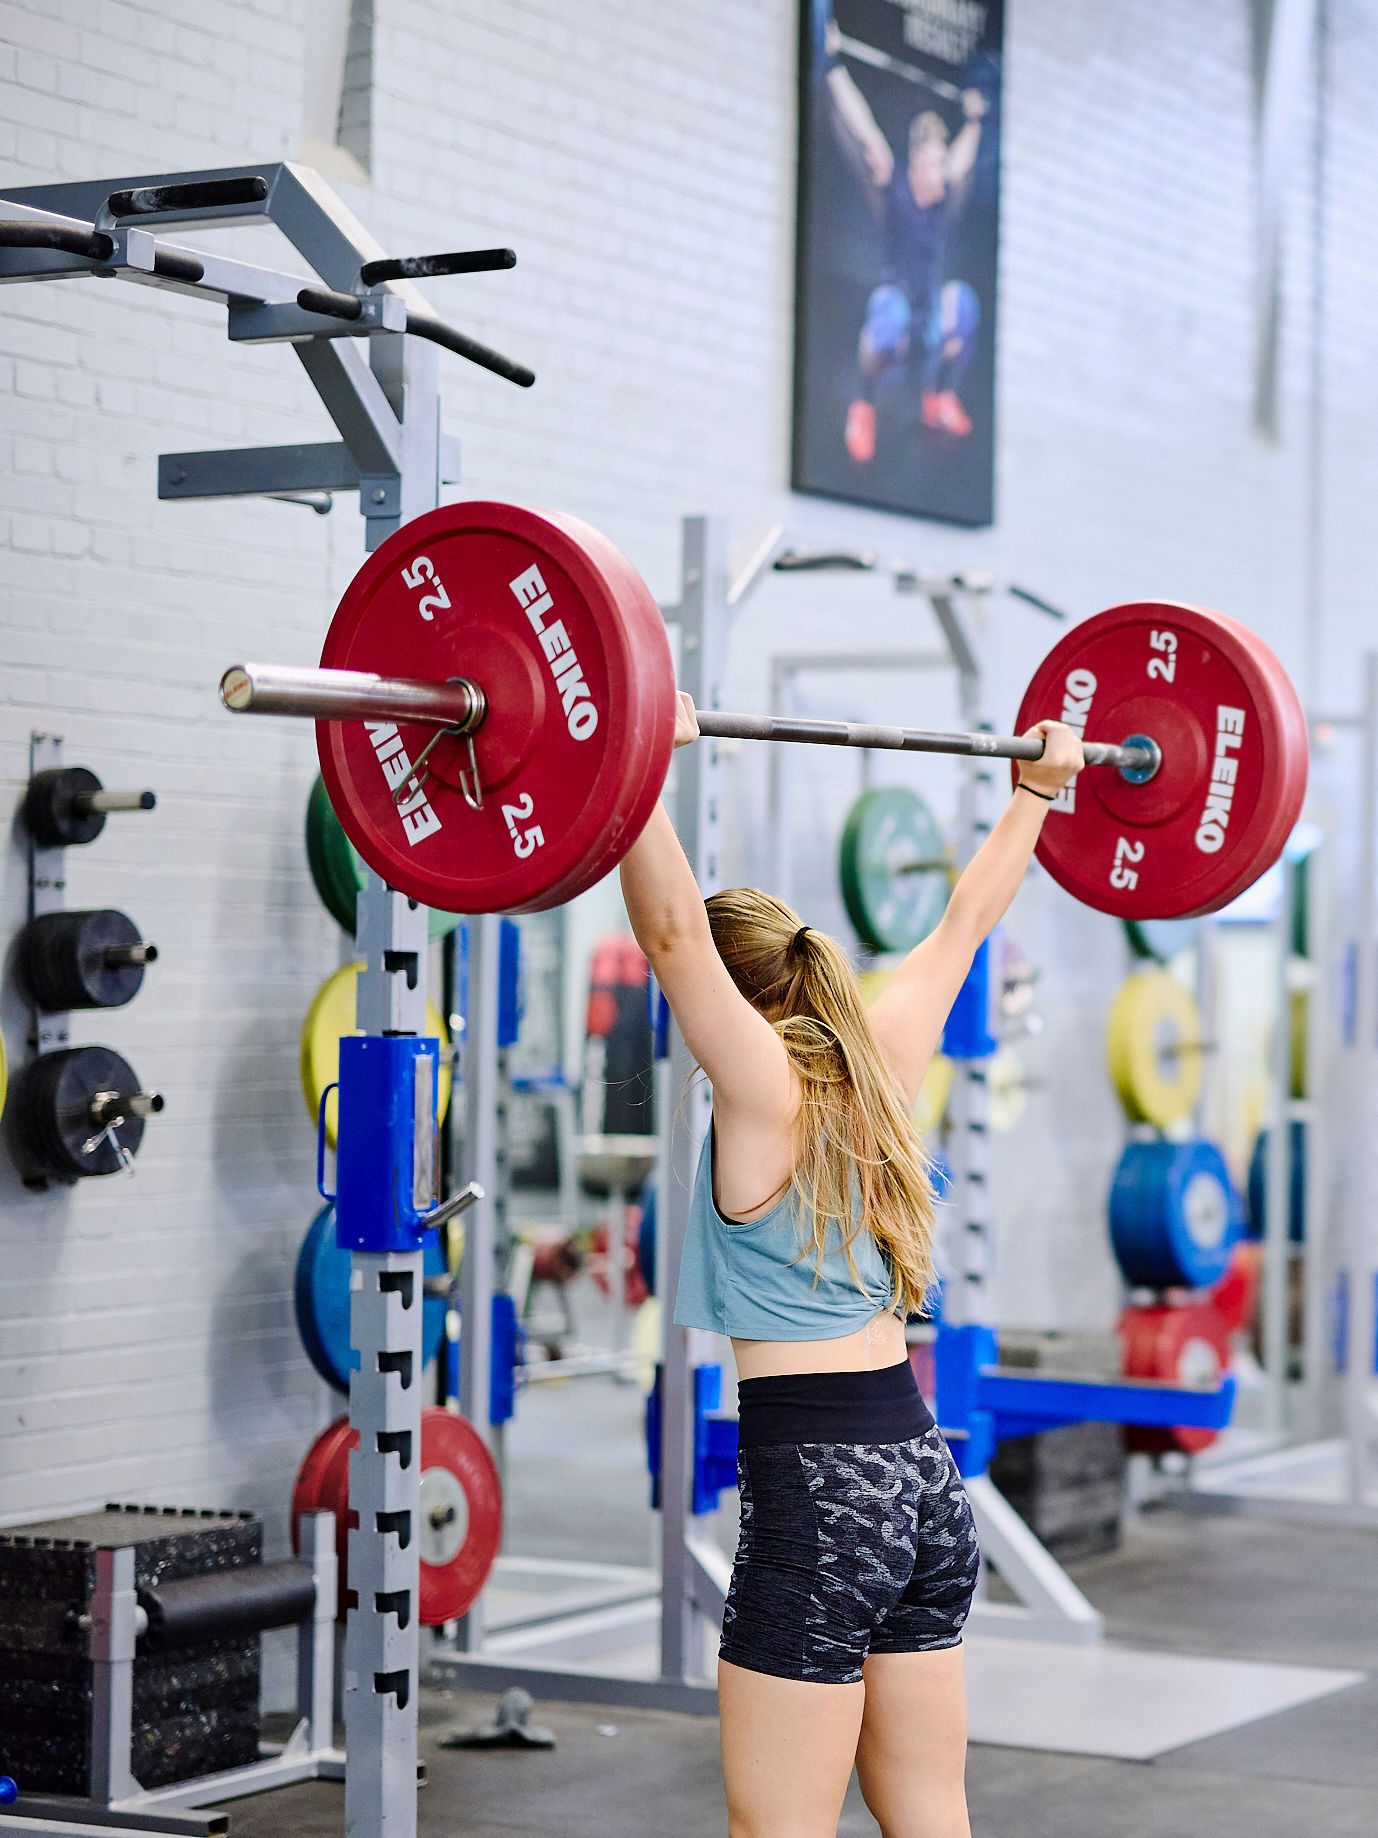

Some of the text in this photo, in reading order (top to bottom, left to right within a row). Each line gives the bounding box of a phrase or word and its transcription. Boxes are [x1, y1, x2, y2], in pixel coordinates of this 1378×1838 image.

[508, 563, 599, 742] ELEIKO
[1147, 630, 1178, 683] 2.5
[363, 720, 443, 847] ELEIK
[501, 792, 545, 859] 2.5
[1195, 705, 1246, 854] ELEIKO
[1109, 837, 1145, 892] 2.5
